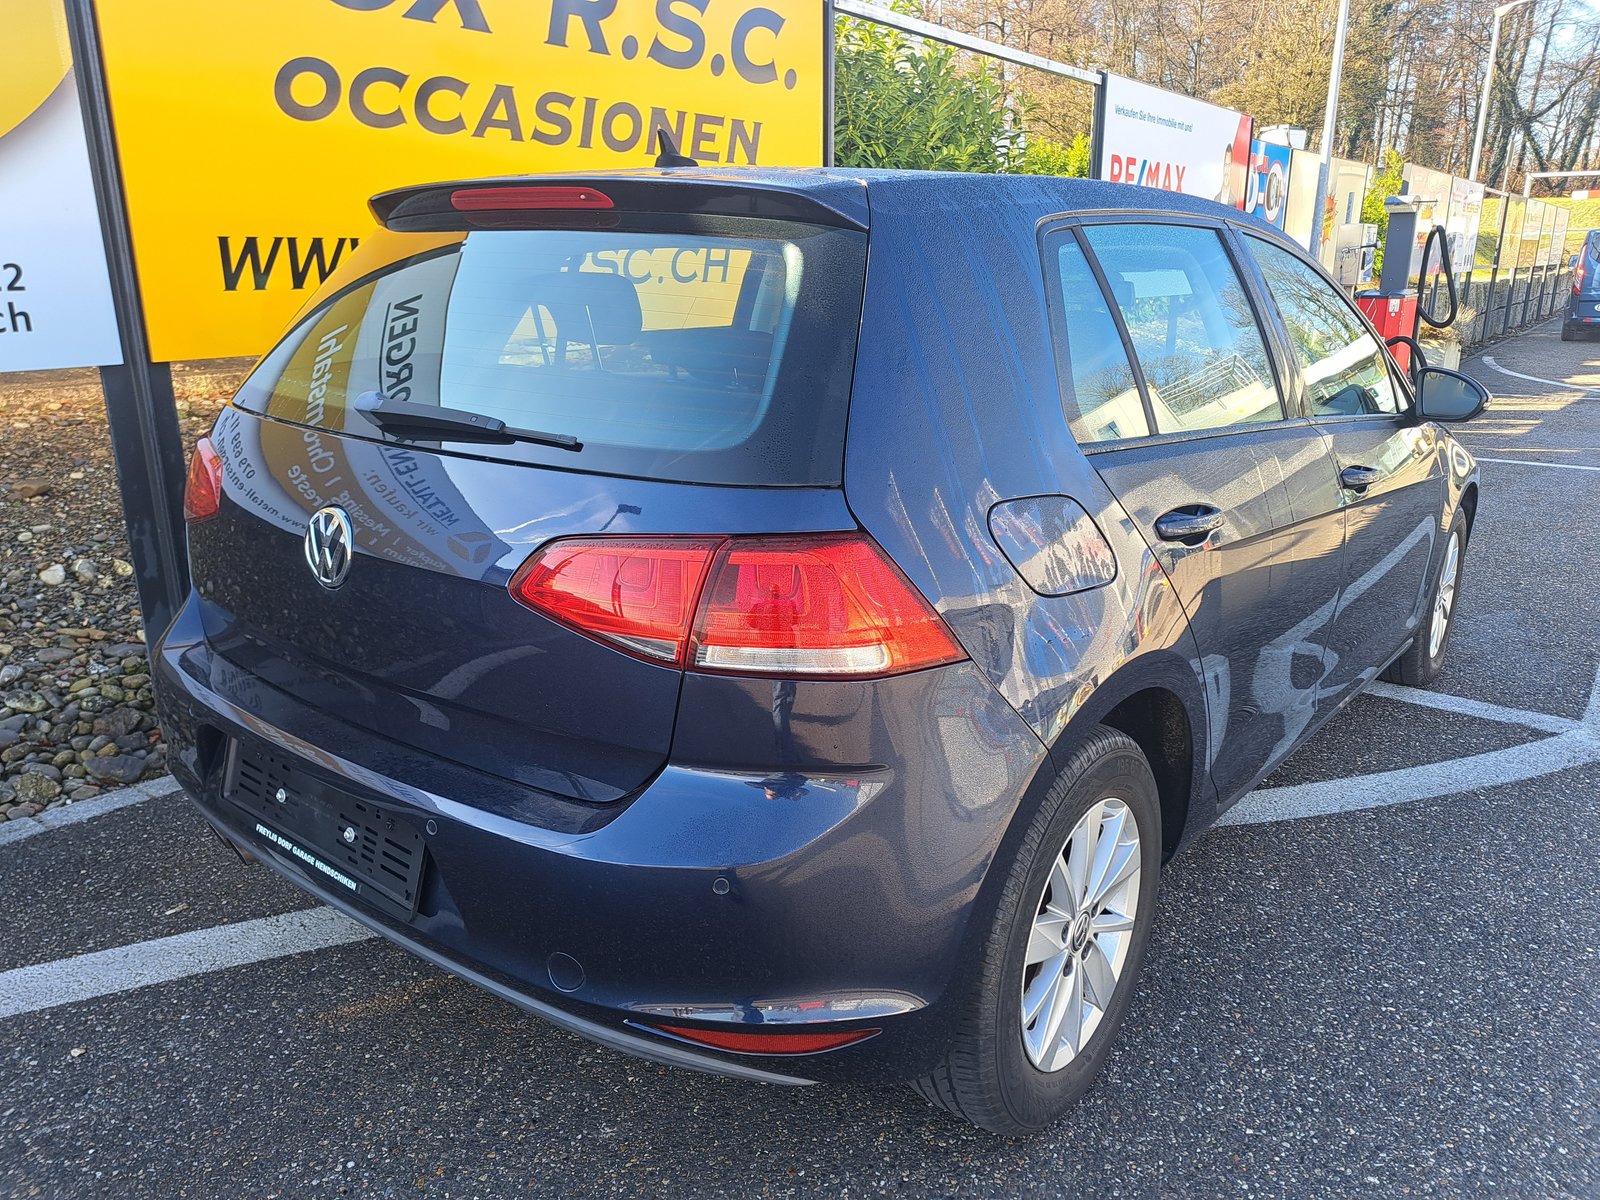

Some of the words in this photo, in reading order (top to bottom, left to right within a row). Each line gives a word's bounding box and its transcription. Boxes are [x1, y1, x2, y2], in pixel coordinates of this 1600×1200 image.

[274, 56, 763, 165] OCCASIONEN
[1115, 104, 1138, 119] Verkaufen
[0, 263, 26, 291] 2
[277, 836, 293, 851] DORF
[292, 846, 316, 865] GARAGE
[315, 860, 357, 891] HENDSCHIKEN
